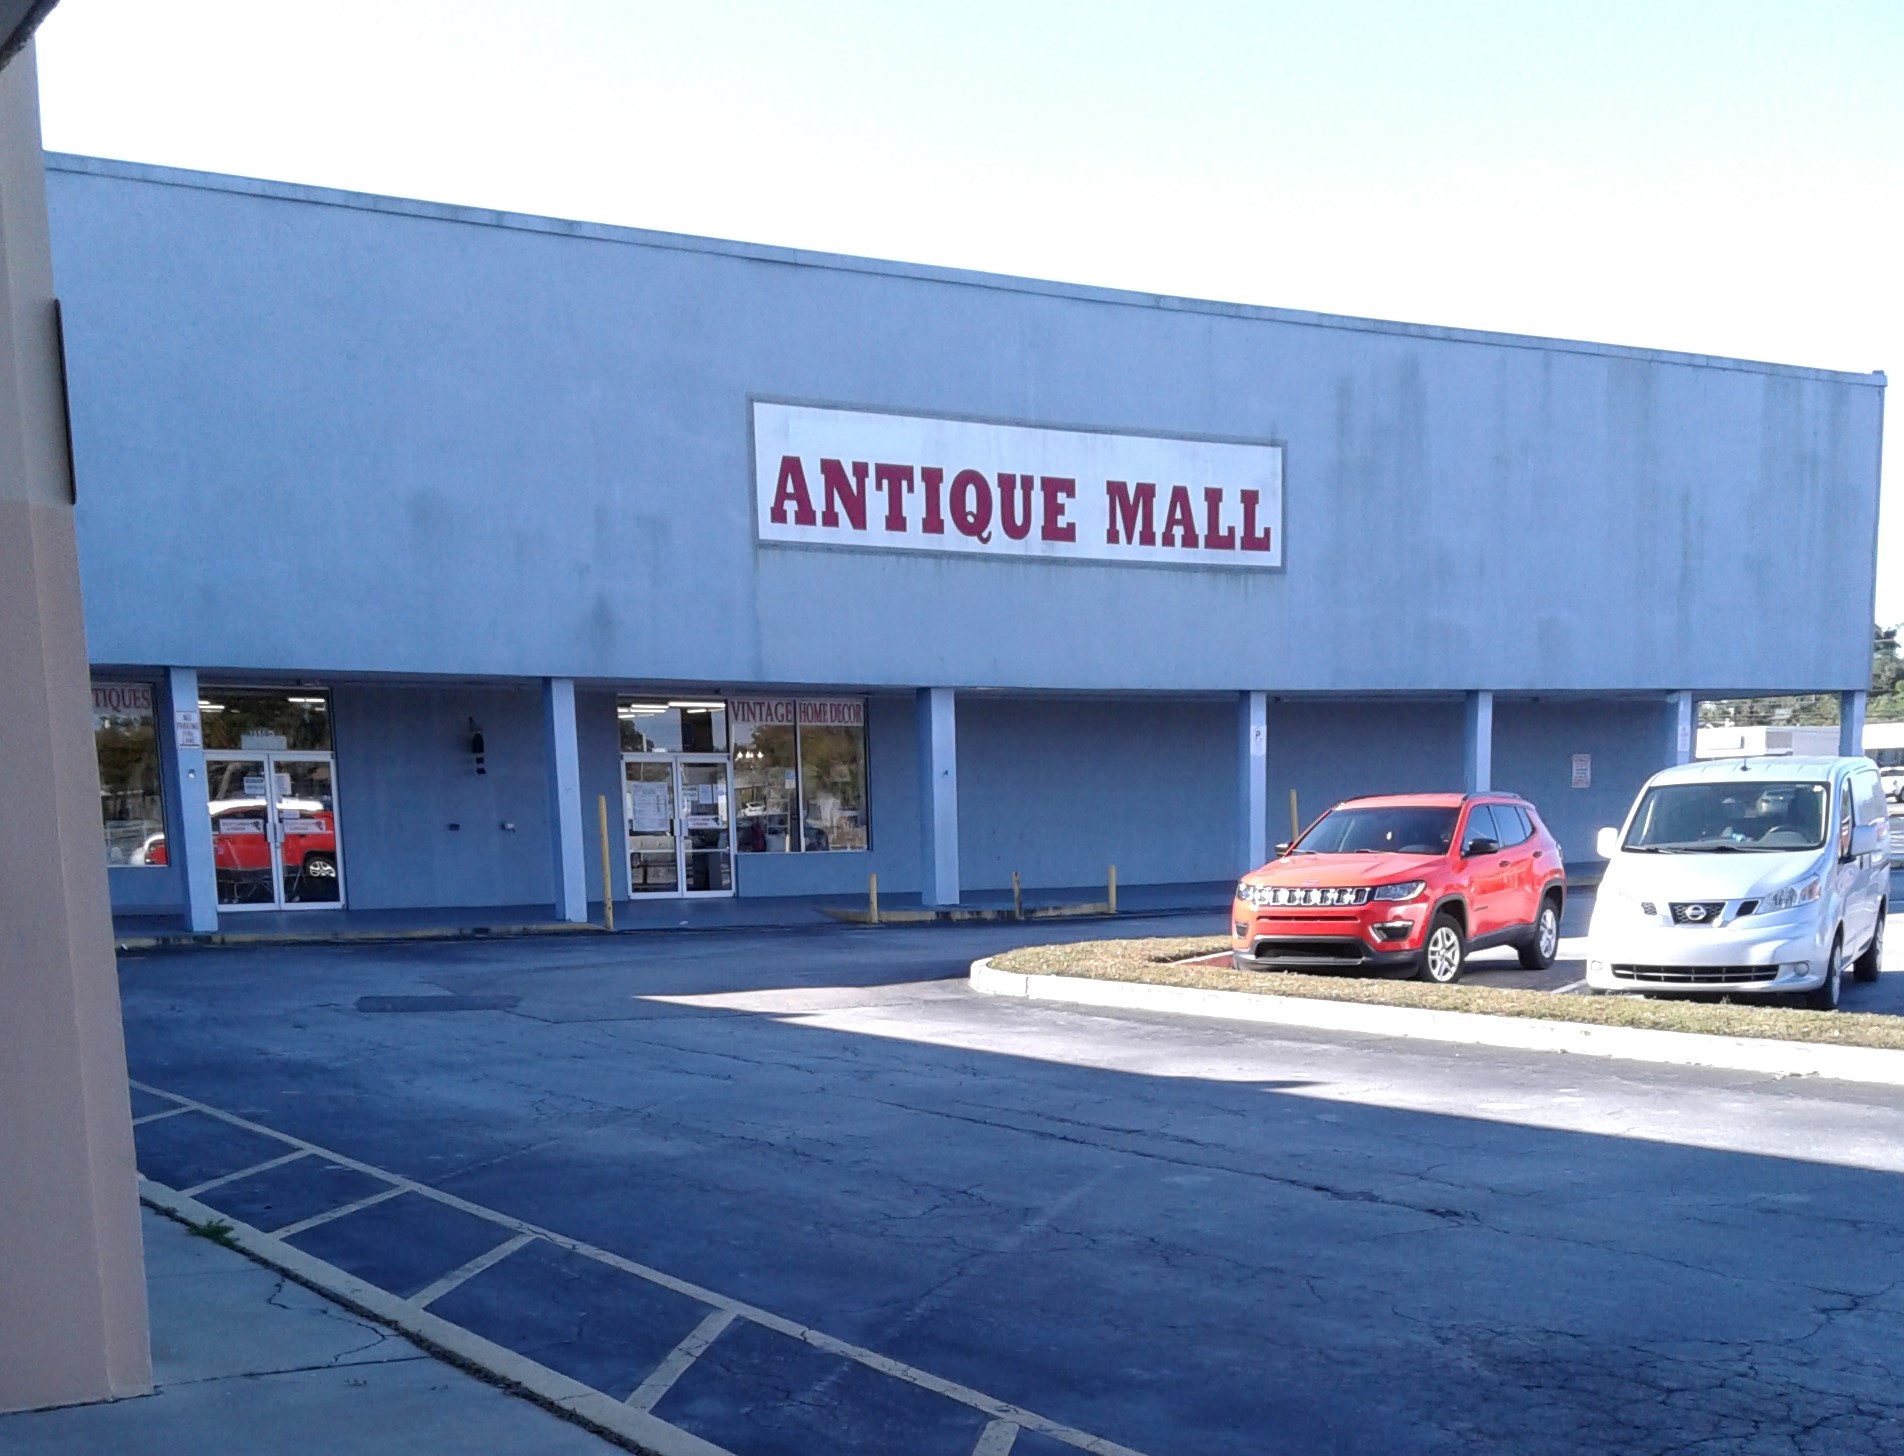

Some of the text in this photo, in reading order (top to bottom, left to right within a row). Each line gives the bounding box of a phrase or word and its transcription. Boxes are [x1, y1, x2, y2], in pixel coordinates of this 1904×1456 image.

[769, 455, 1271, 552] ANTIQUE MALL
[730, 701, 862, 724] VINTAGE HOME DECOR
